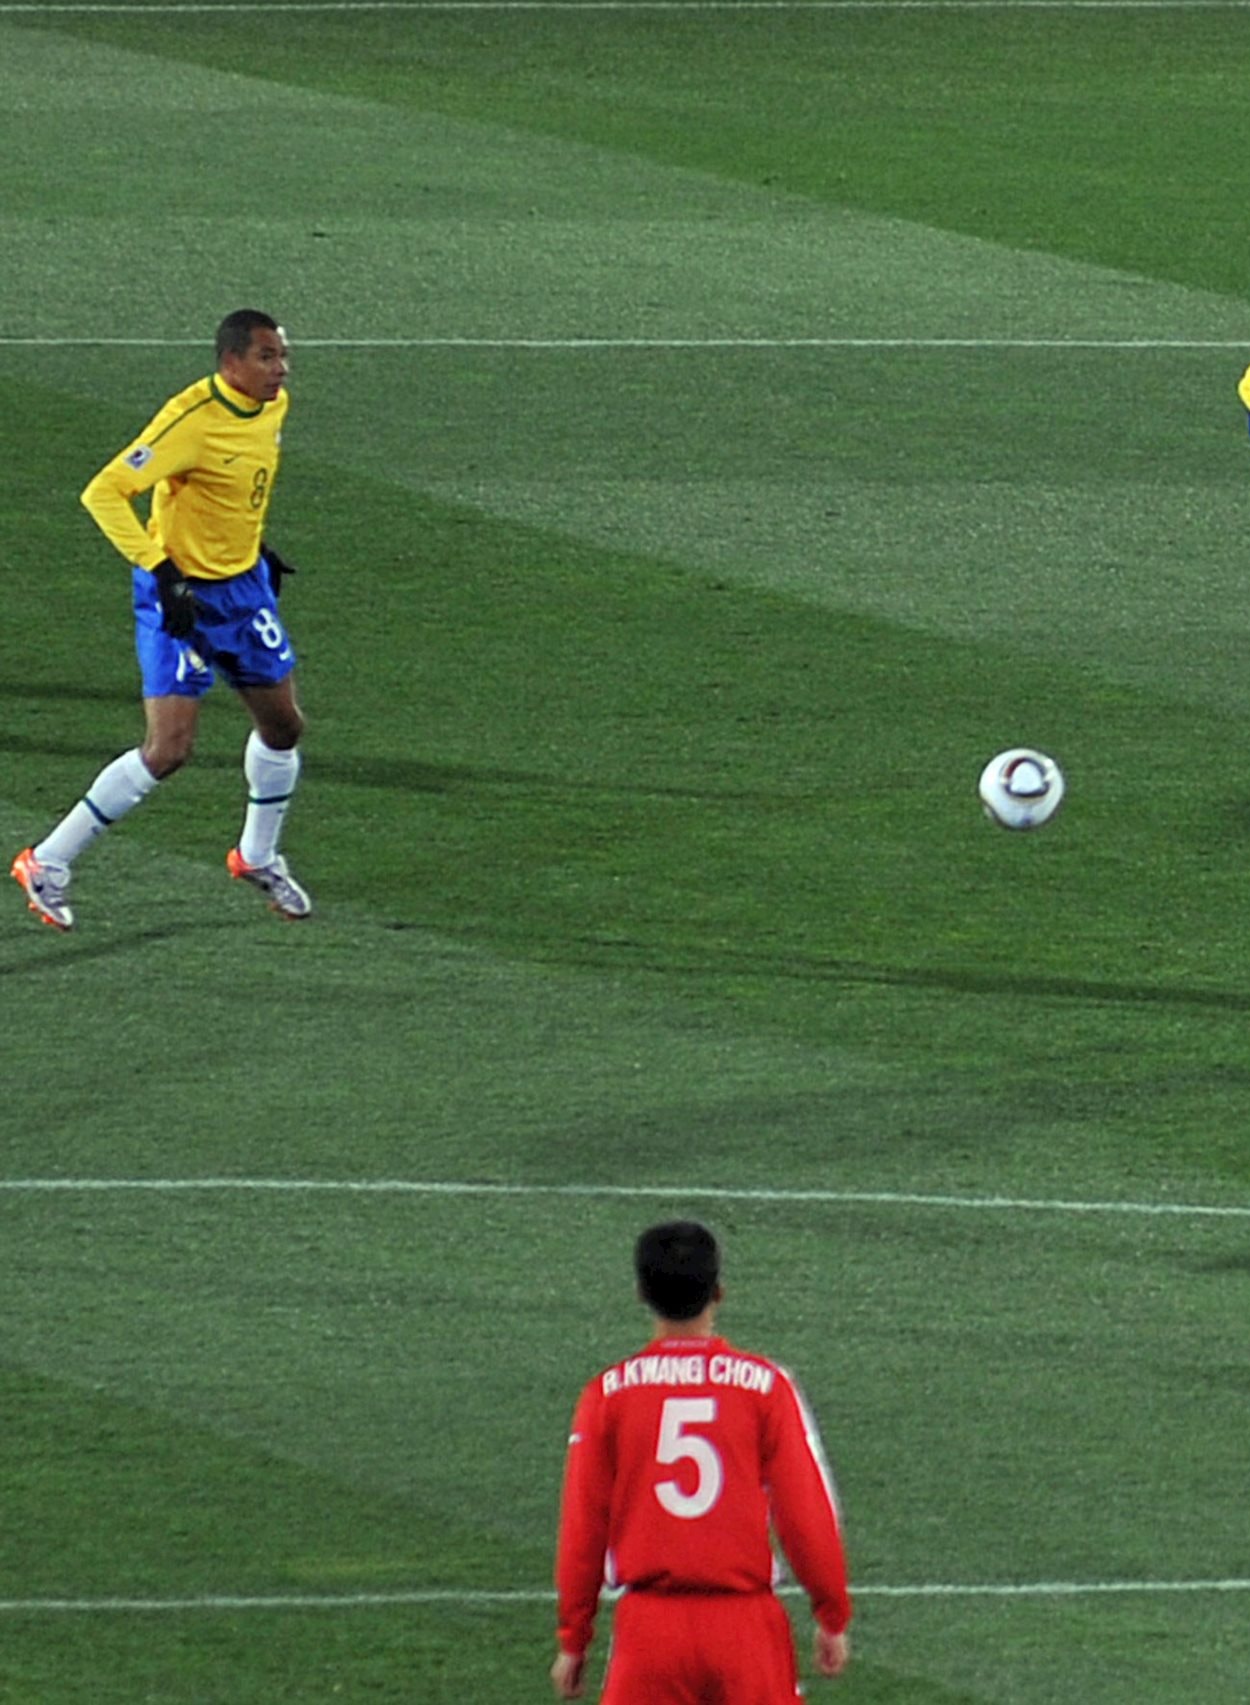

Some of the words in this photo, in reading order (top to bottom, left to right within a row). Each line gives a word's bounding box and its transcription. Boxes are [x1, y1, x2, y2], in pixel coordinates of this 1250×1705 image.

[250, 467, 268, 510] 8
[252, 608, 282, 648] 8
[709, 1354, 775, 1395] CHON
[654, 1397, 724, 1520] 5
